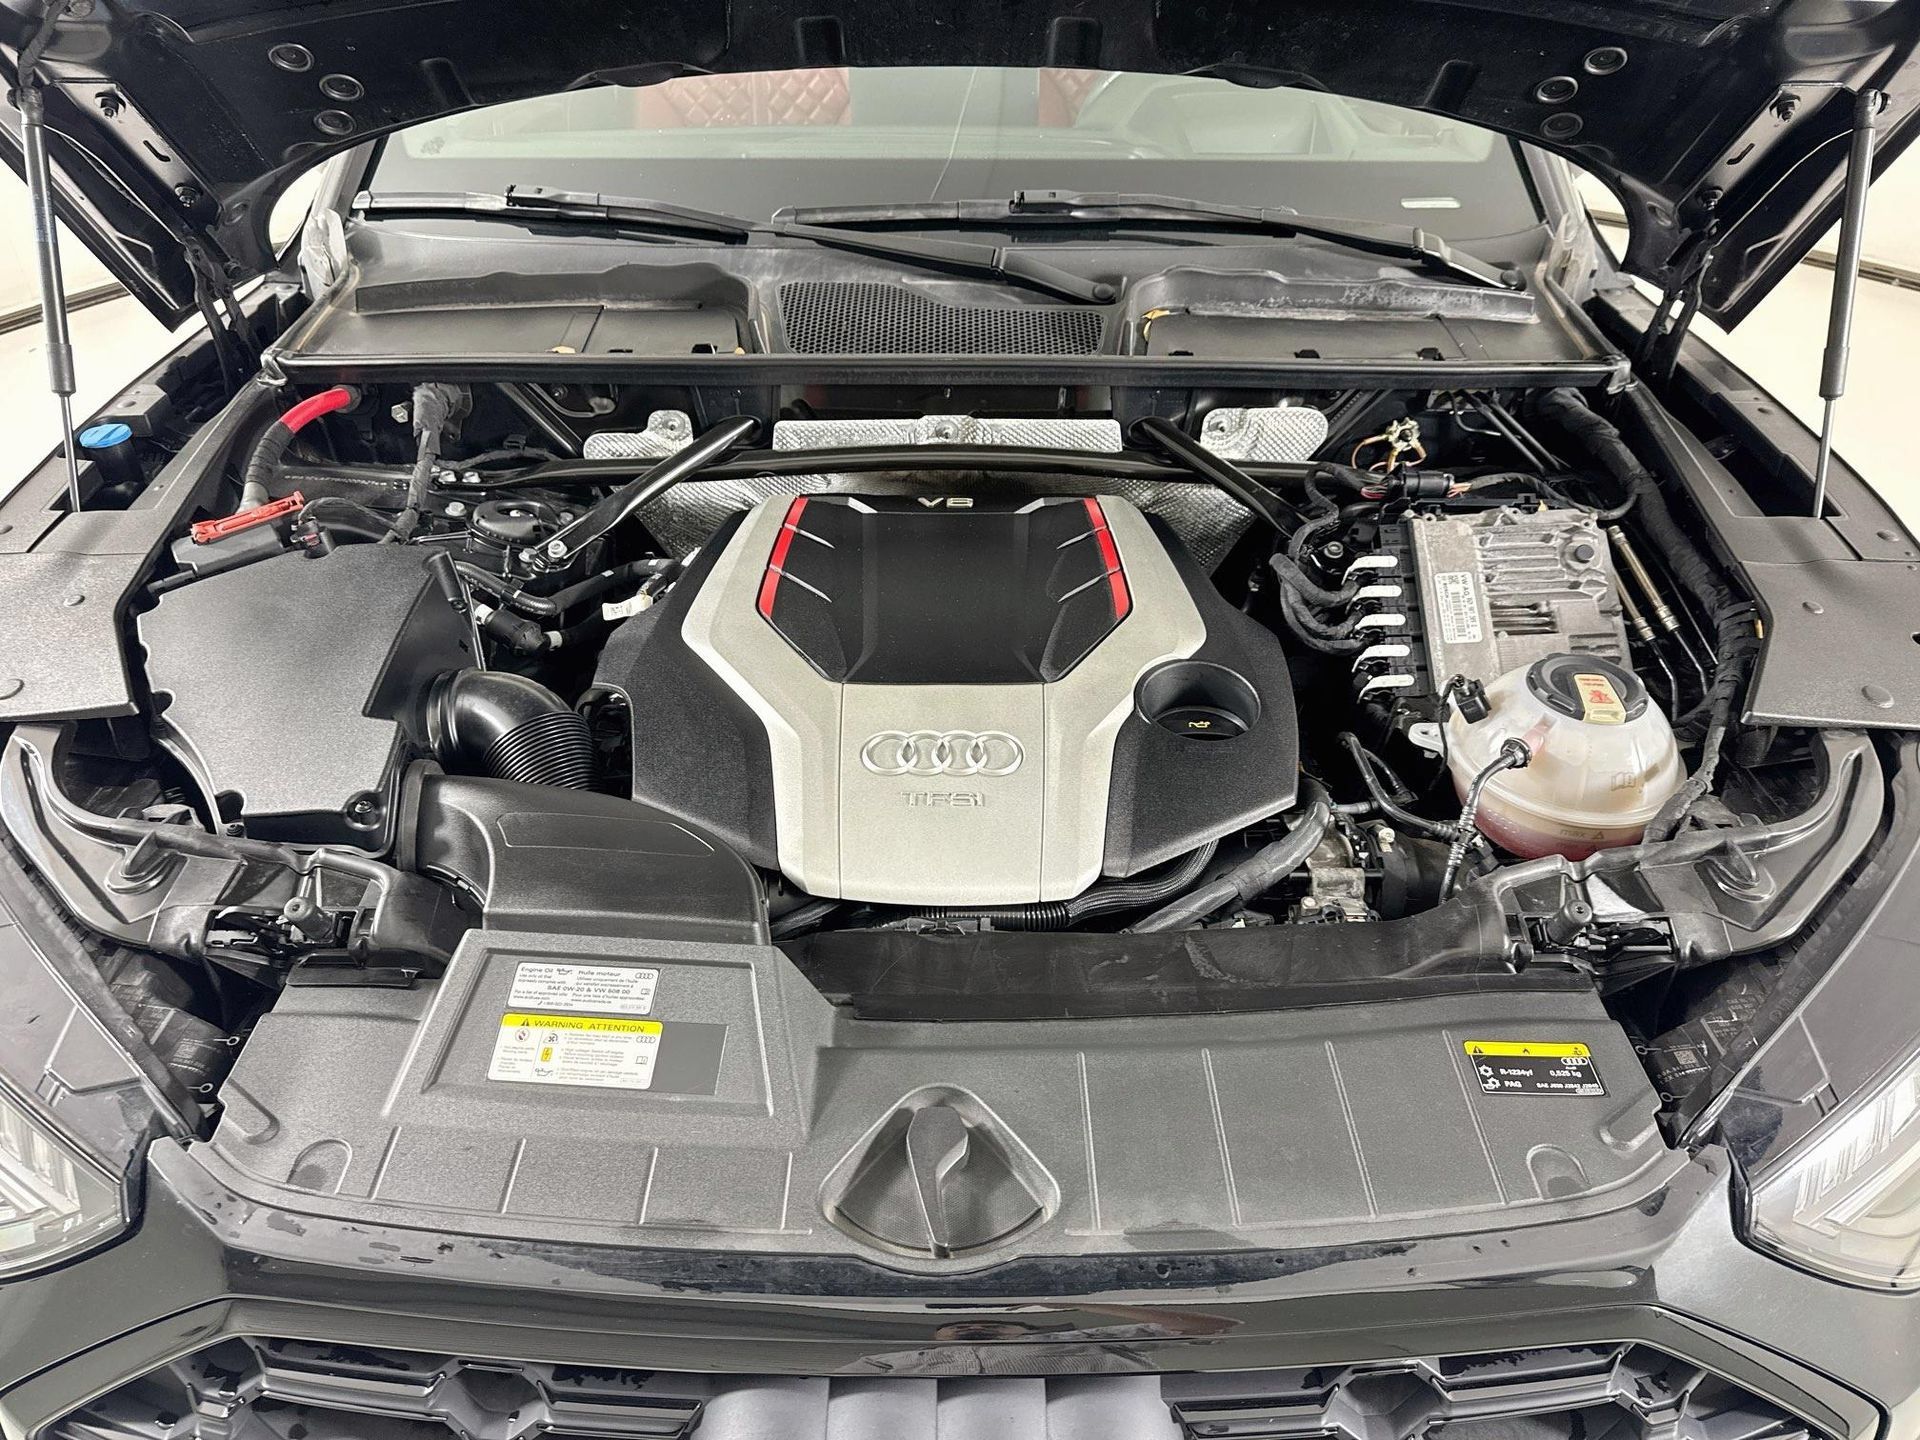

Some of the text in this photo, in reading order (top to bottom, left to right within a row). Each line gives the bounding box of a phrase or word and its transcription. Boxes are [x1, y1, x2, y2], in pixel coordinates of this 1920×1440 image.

[900, 791, 986, 807] TFSI
[534, 1020, 645, 1033] WARNING ATTENTION
[1504, 1080, 1523, 1088] PAG
